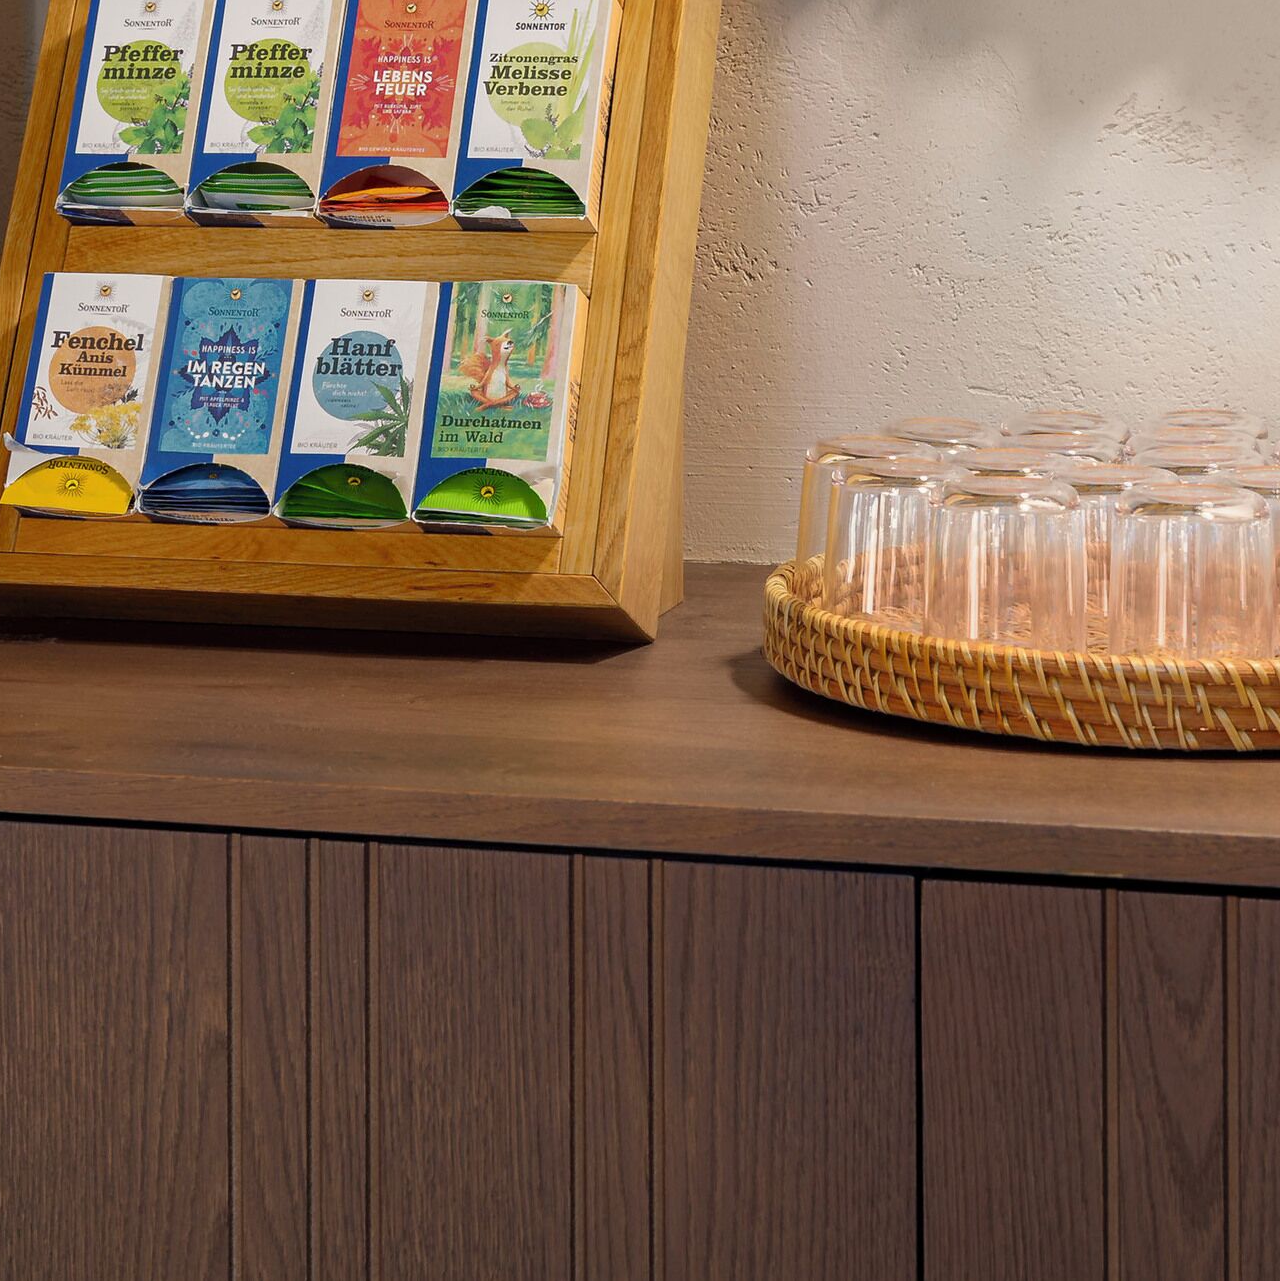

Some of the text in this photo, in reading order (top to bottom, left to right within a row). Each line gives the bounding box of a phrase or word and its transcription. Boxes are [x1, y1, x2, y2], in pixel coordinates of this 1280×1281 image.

[124, 18, 173, 27] SONNENTOR
[251, 17, 300, 26] SONNENTOR
[384, 20, 434, 29] SONNENTOR
[515, 22, 567, 31] SONNENTOR
[101, 44, 184, 62] Pfeffer
[229, 43, 312, 61] Pfeffer
[377, 55, 432, 64] HAPPINESS IS
[489, 53, 578, 65] Zitronengras
[102, 63, 176, 80] minze
[230, 62, 305, 79] minze
[373, 70, 433, 83] LEBENS
[490, 65, 572, 80] Melisse
[375, 83, 428, 96] FEUER
[483, 81, 568, 97] Verbene
[78, 302, 129, 313] SONNENTOR
[208, 306, 260, 317] SONNENTOR
[340, 307, 393, 318] SONNENTOR
[481, 309, 529, 319] SONNENTOR
[50, 330, 144, 351] Fenchel
[329, 337, 396, 357] Hanf
[201, 345, 257, 354] HAPPINESS IS
[76, 351, 114, 364] Anis
[58, 363, 127, 378] Kümmel
[186, 360, 266, 375] IM REGEN
[316, 356, 403, 377] blätter
[193, 374, 257, 389] TANZEN
[439, 415, 542, 430] Durchatmen
[438, 430, 504, 444] im Wald
